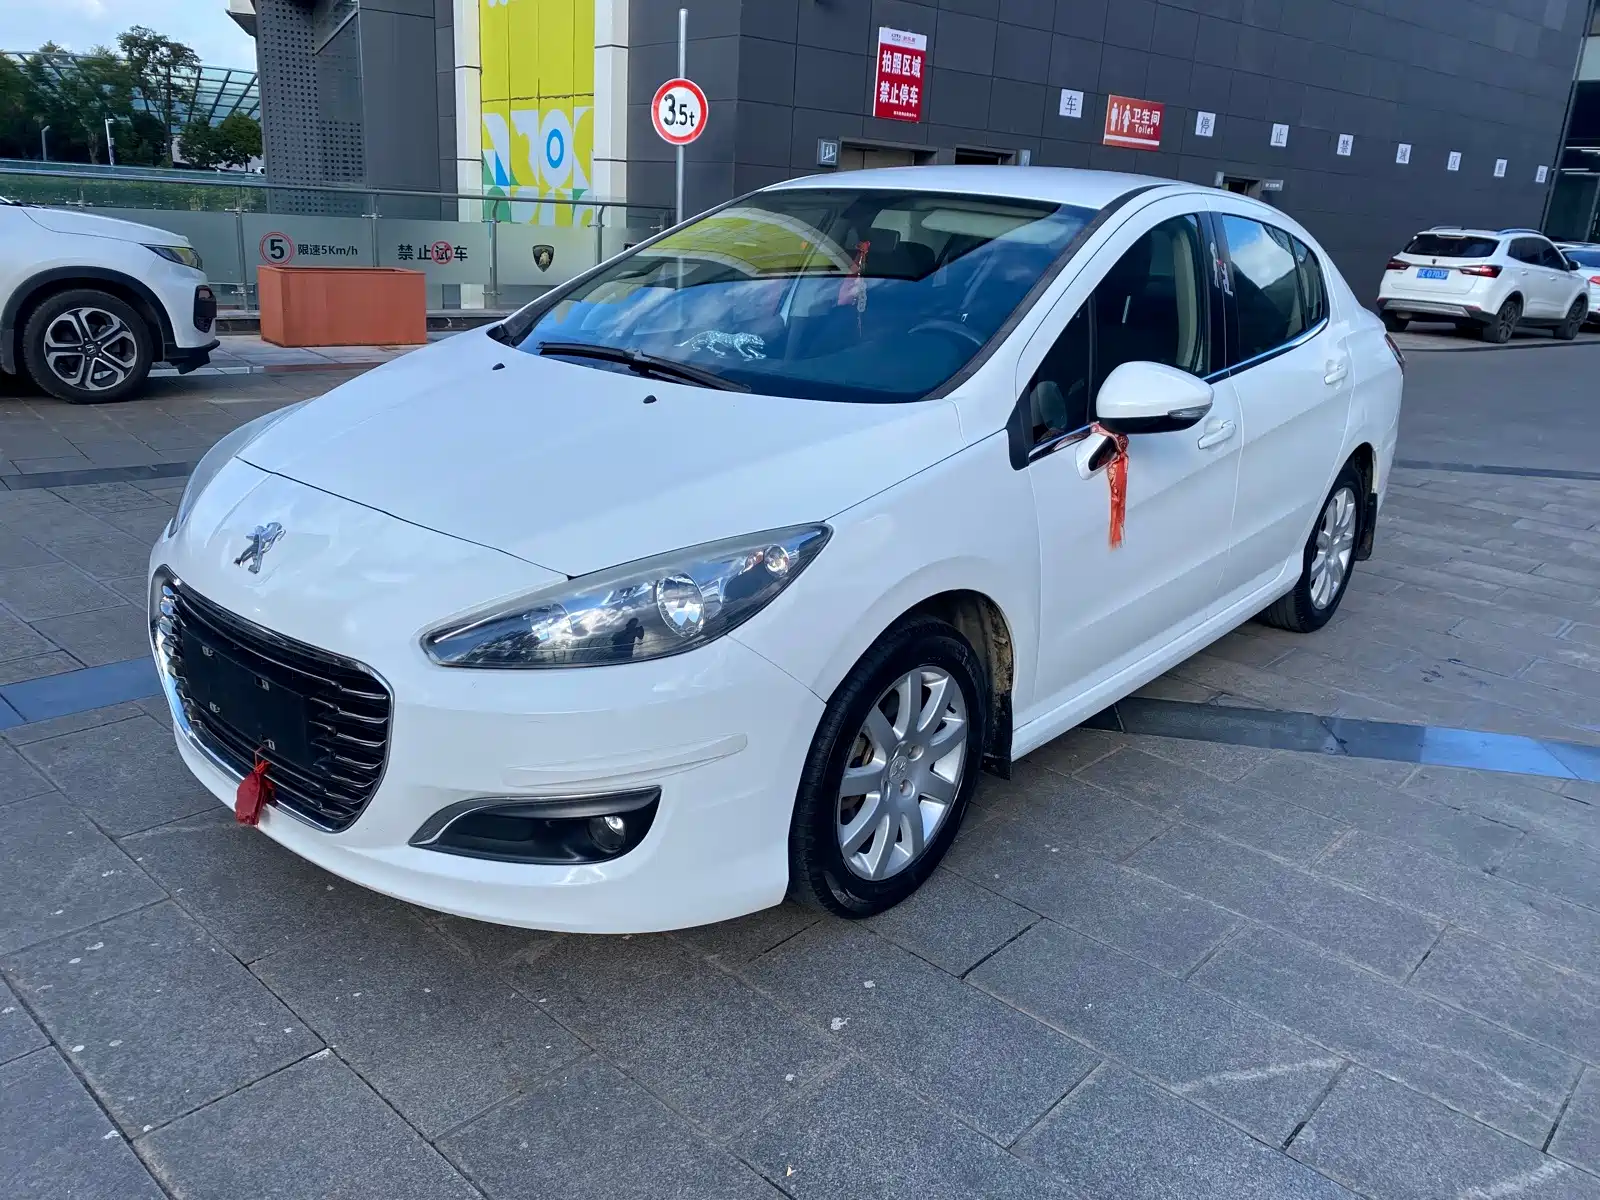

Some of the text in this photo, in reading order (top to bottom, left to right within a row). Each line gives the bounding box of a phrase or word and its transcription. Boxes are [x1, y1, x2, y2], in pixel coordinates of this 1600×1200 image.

[881, 49, 922, 78] 拍照区域
[879, 80, 919, 108] 禁止停车
[663, 93, 695, 127] 3.5t
[1064, 95, 1078, 115] 车
[1274, 127, 1284, 144] 止
[1131, 107, 1161, 127] 卫生间
[1135, 124, 1154, 135] Toilet
[269, 238, 285, 260] 5
[297, 243, 358, 257] 限速5Km/h
